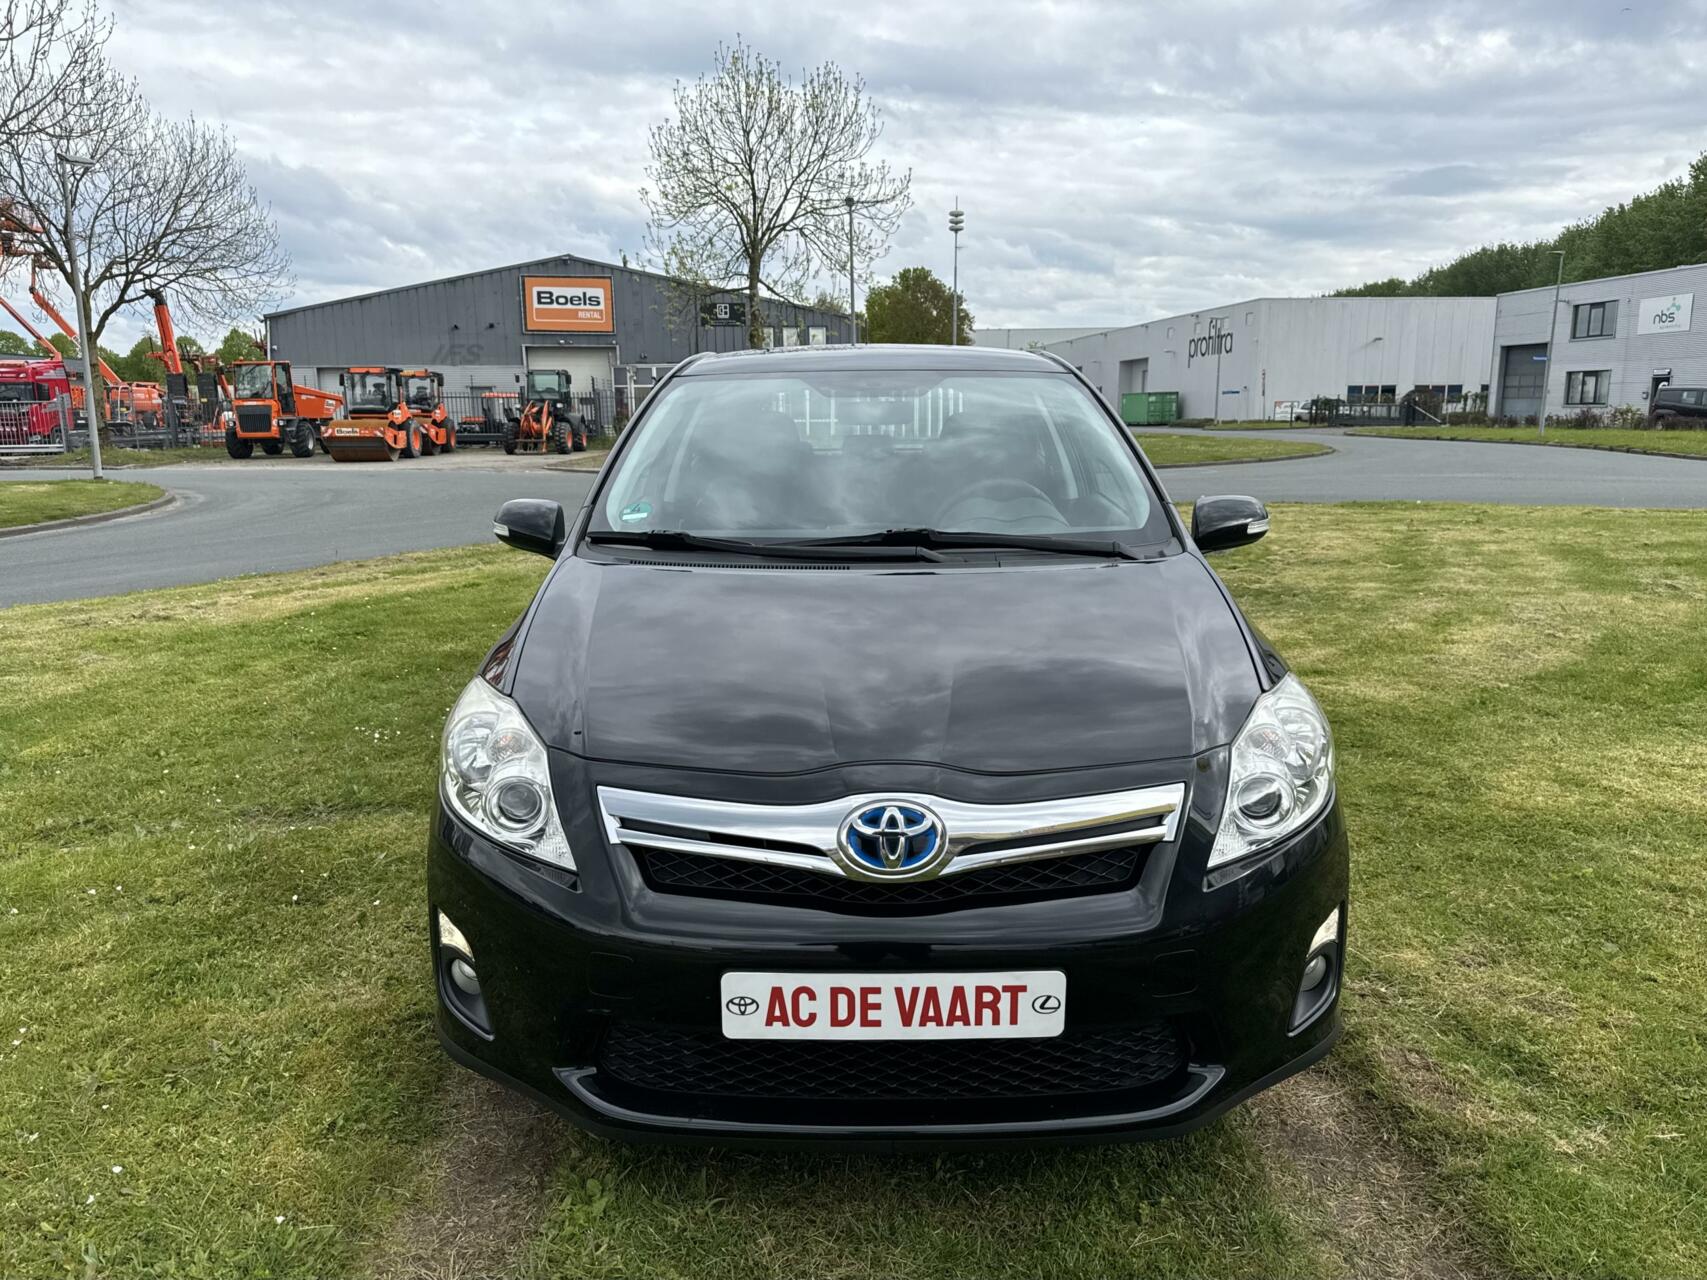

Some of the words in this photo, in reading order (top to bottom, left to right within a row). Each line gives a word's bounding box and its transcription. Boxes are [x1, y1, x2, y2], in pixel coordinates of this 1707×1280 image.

[536, 290, 601, 306] Boels
[578, 310, 602, 319] RENTAL
[1653, 310, 1675, 324] nbs
[1187, 319, 1233, 368] profiltra
[765, 986, 817, 1027] AC
[829, 986, 882, 1027] DE
[894, 985, 1028, 1027] VAART
